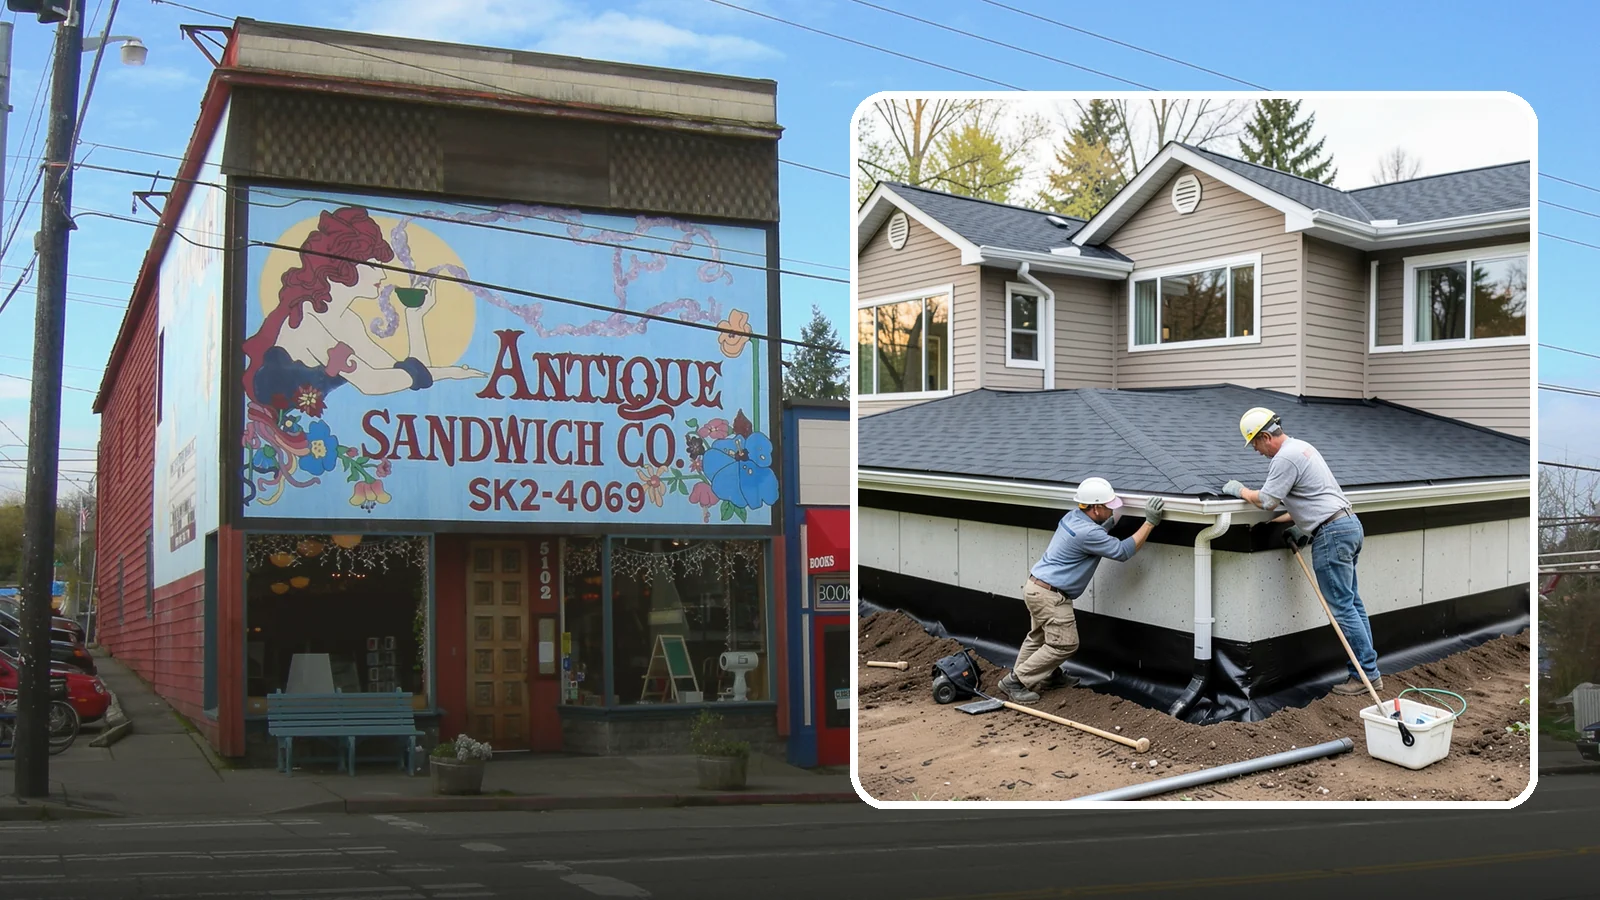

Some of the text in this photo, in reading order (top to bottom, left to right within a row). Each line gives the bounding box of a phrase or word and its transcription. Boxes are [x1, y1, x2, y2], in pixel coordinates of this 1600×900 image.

[475, 329, 723, 421] ANTIQUE
[361, 408, 685, 468] SANDWICH CO.
[468, 477, 645, 513] SK2-4069
[540, 541, 551, 600] 5102
[809, 555, 835, 569] BOOKS
